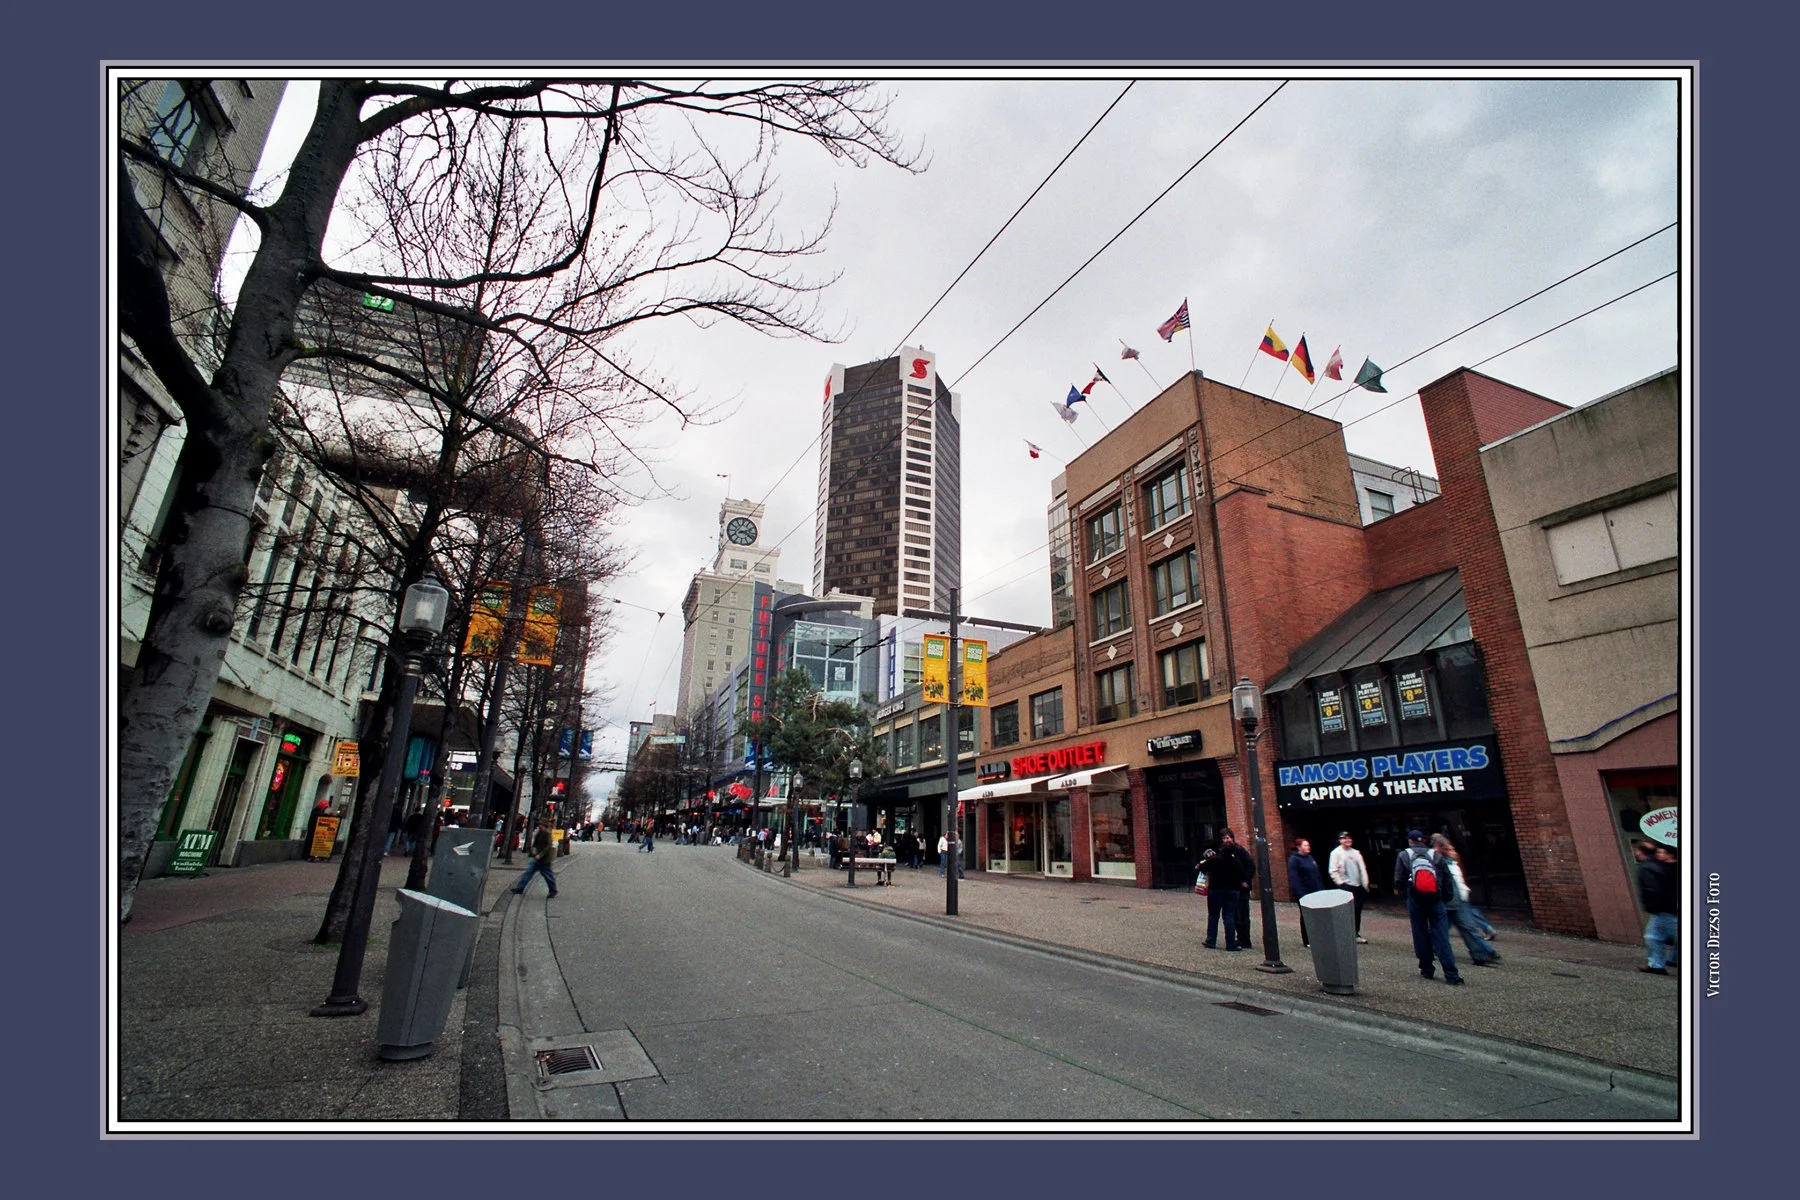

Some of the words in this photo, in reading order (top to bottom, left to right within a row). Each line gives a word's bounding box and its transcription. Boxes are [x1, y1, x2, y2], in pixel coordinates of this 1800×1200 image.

[755, 595, 769, 685] FUTURE
[1402, 672, 1416, 680] NOW
[1012, 752, 1048, 777] SHOE
[1048, 741, 1106, 770] OUTLET
[1279, 758, 1369, 787] FAMOUS
[1371, 745, 1489, 778] PLAYERS
[1061, 778, 1077, 788] ALDO
[1300, 783, 1364, 802] CAPITOL
[1368, 782, 1379, 797] 6
[1383, 775, 1465, 796] THEATRE
[178, 833, 214, 850] ATM
